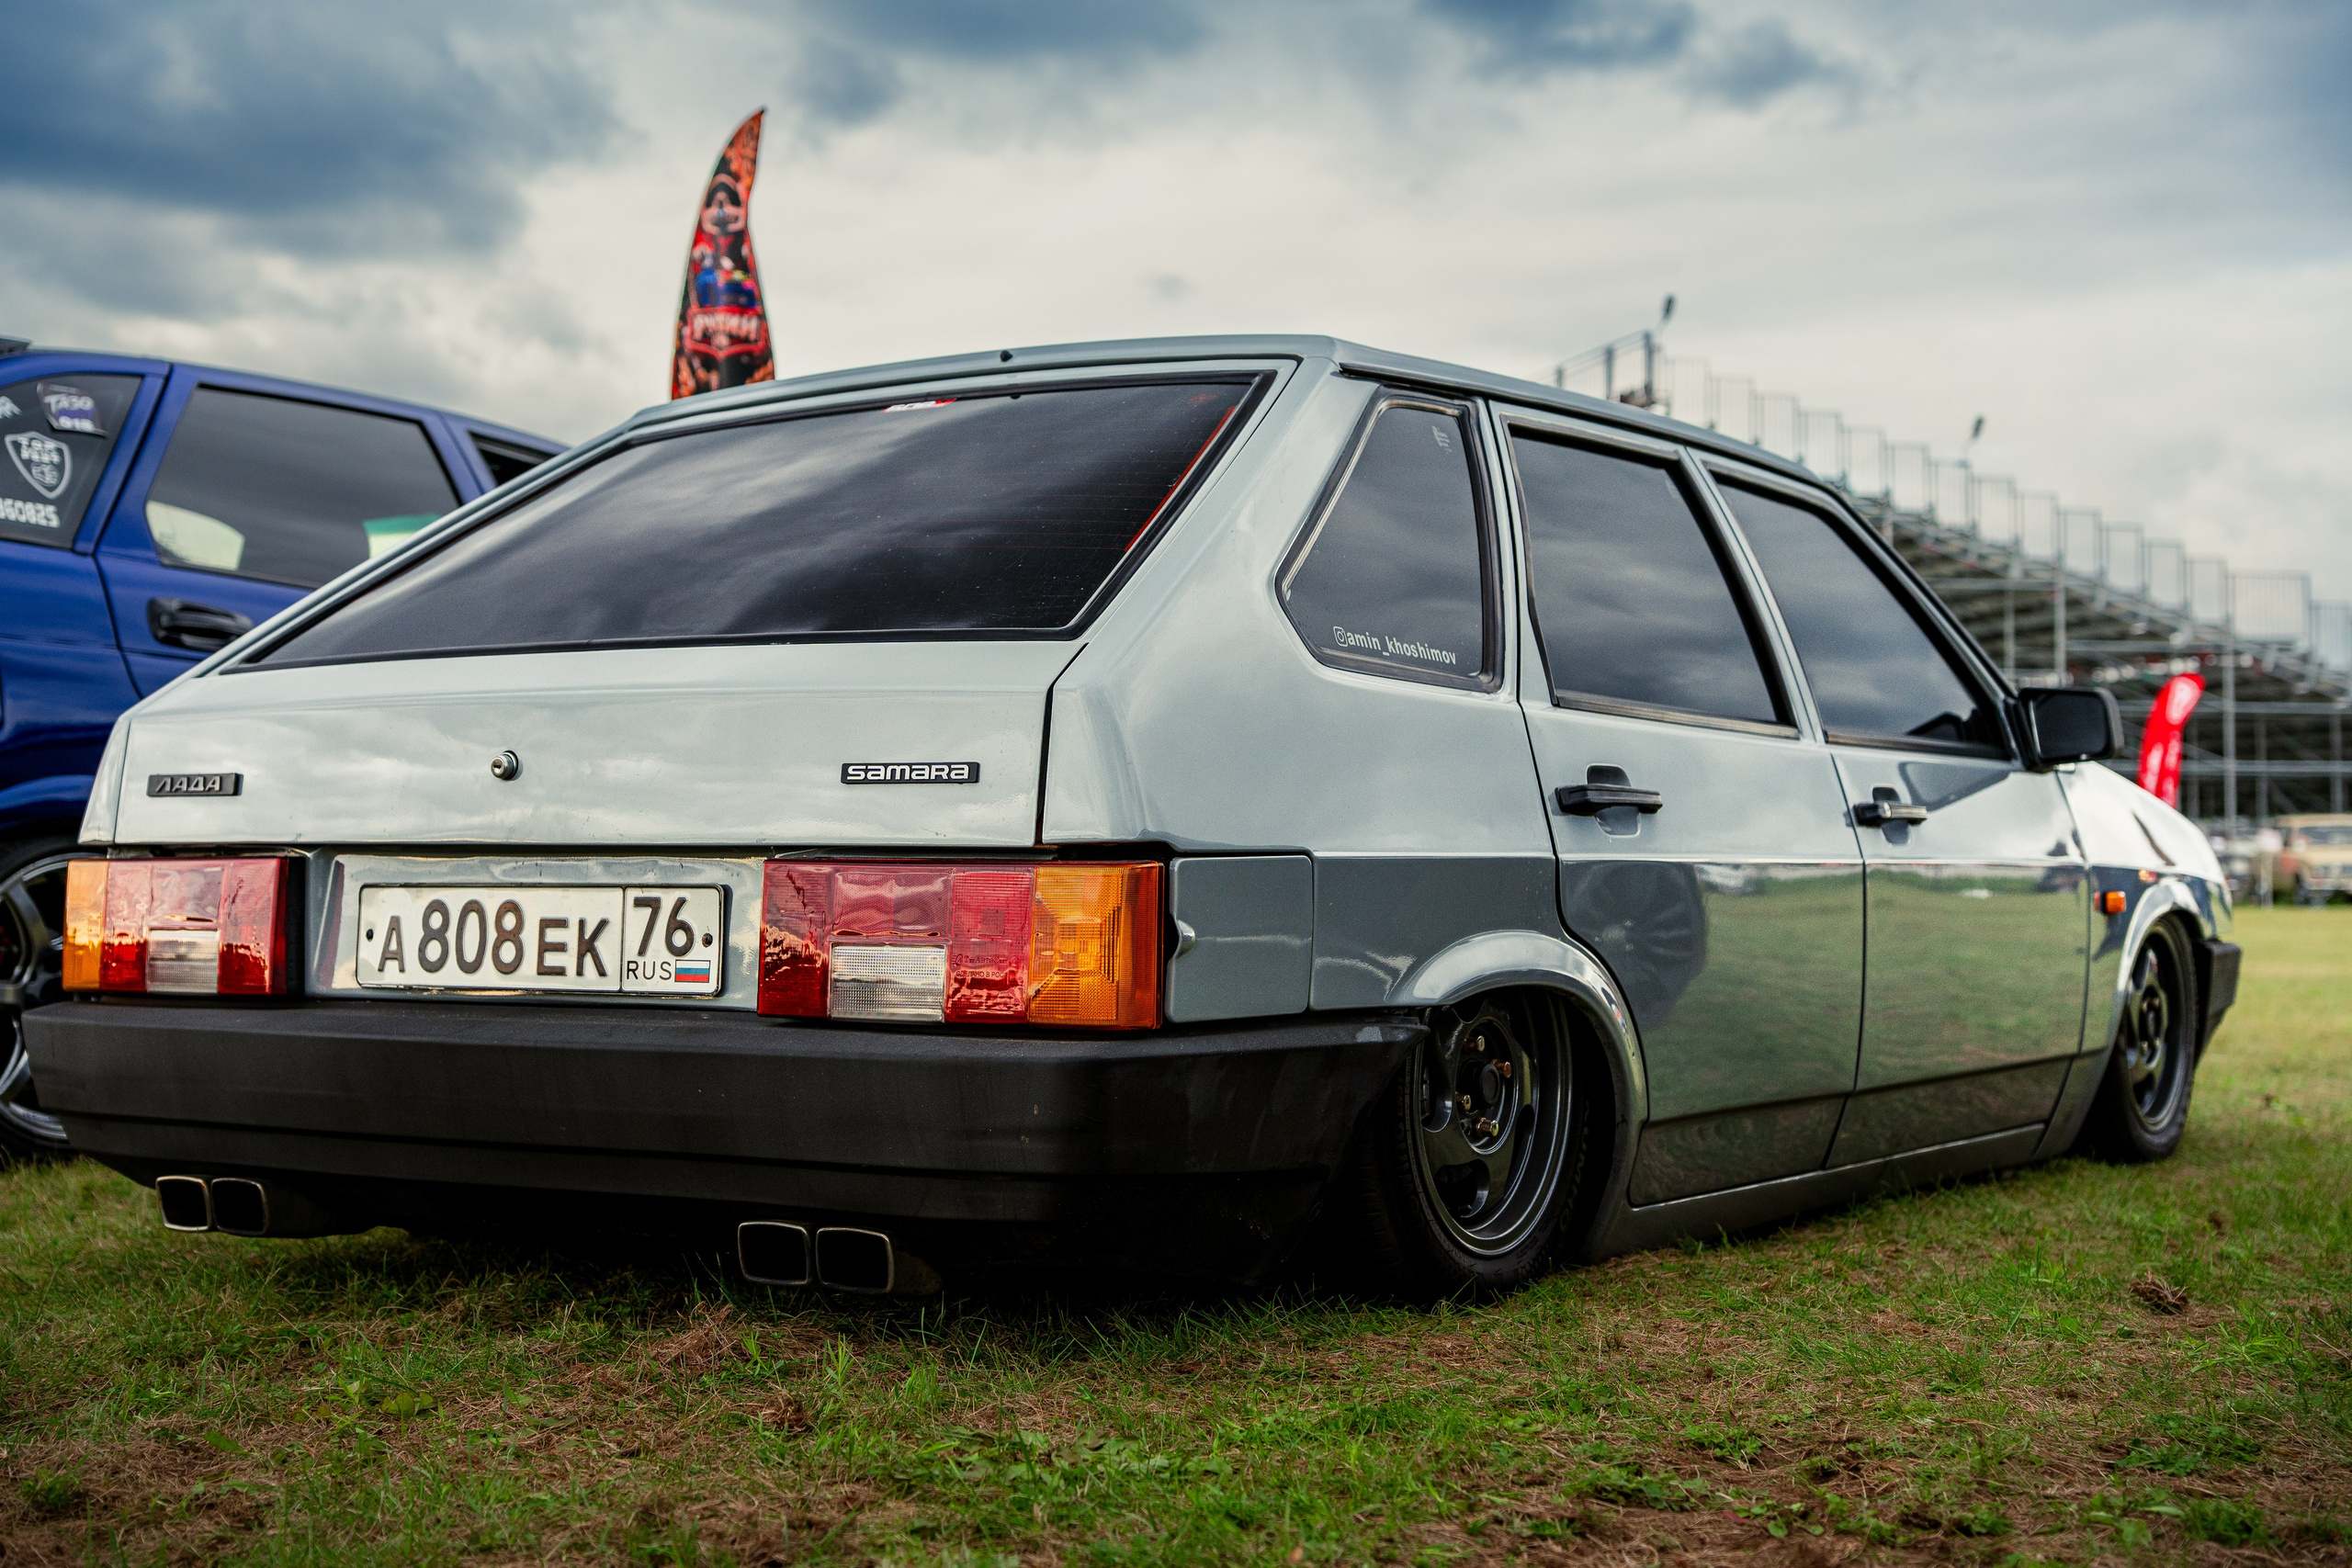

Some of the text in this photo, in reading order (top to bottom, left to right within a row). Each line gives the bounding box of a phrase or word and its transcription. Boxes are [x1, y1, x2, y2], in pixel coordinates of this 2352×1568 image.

[1347, 631, 1457, 665] amin_khoshimov
[155, 775, 220, 793] ЛАДА
[633, 897, 695, 958] 76
[626, 960, 673, 980] RUS
